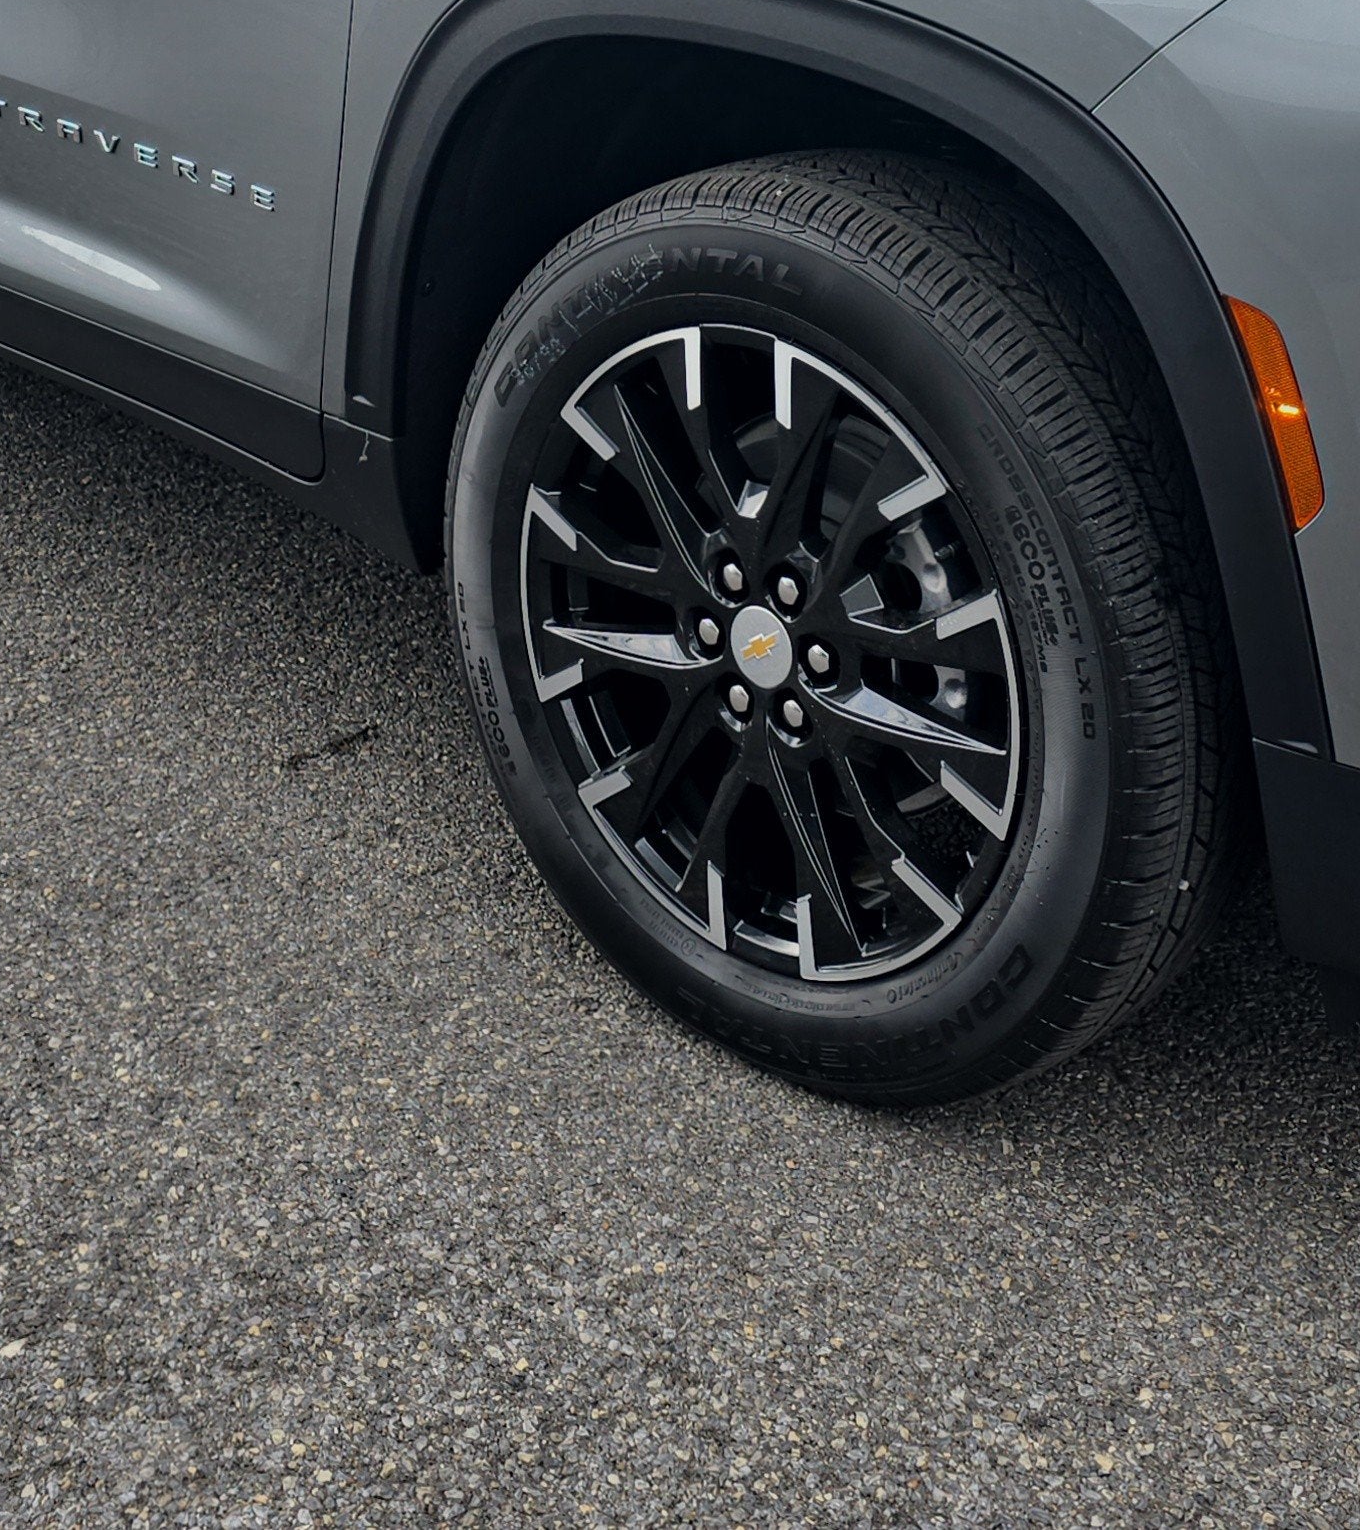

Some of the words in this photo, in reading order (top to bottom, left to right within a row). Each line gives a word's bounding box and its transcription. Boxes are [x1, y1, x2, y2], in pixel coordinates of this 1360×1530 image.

[486, 244, 805, 408] CONTINENTAL
[1073, 656, 1093, 696] LX
[1080, 701, 1097, 741] 20
